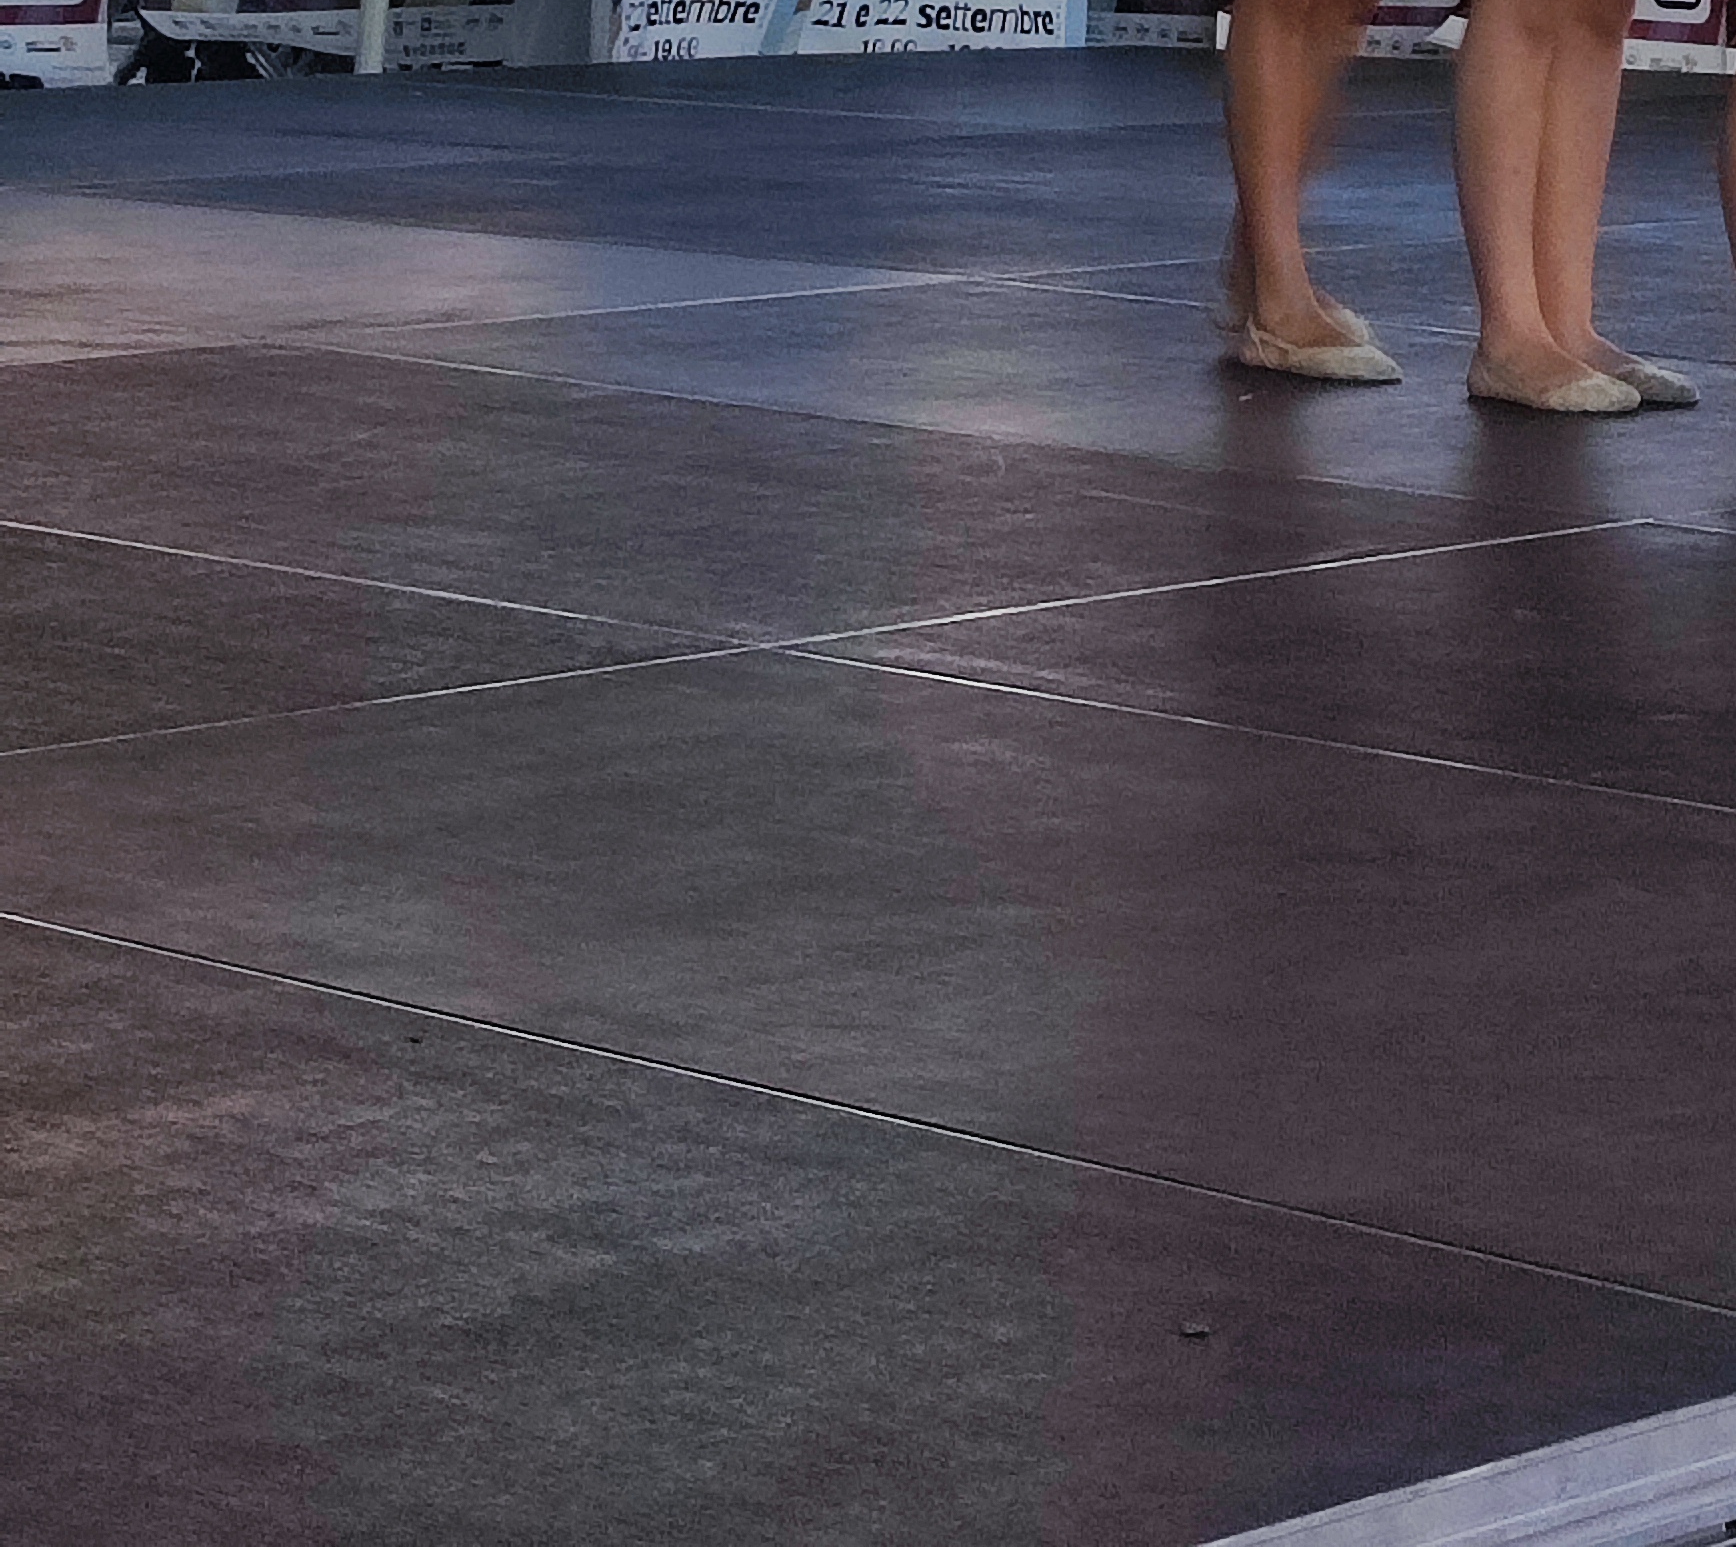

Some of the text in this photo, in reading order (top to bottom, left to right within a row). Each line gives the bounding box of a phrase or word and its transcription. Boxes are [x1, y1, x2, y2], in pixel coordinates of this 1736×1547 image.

[810, 0, 846, 30] 21
[854, 3, 870, 28] e
[915, 1, 1055, 36] settembre
